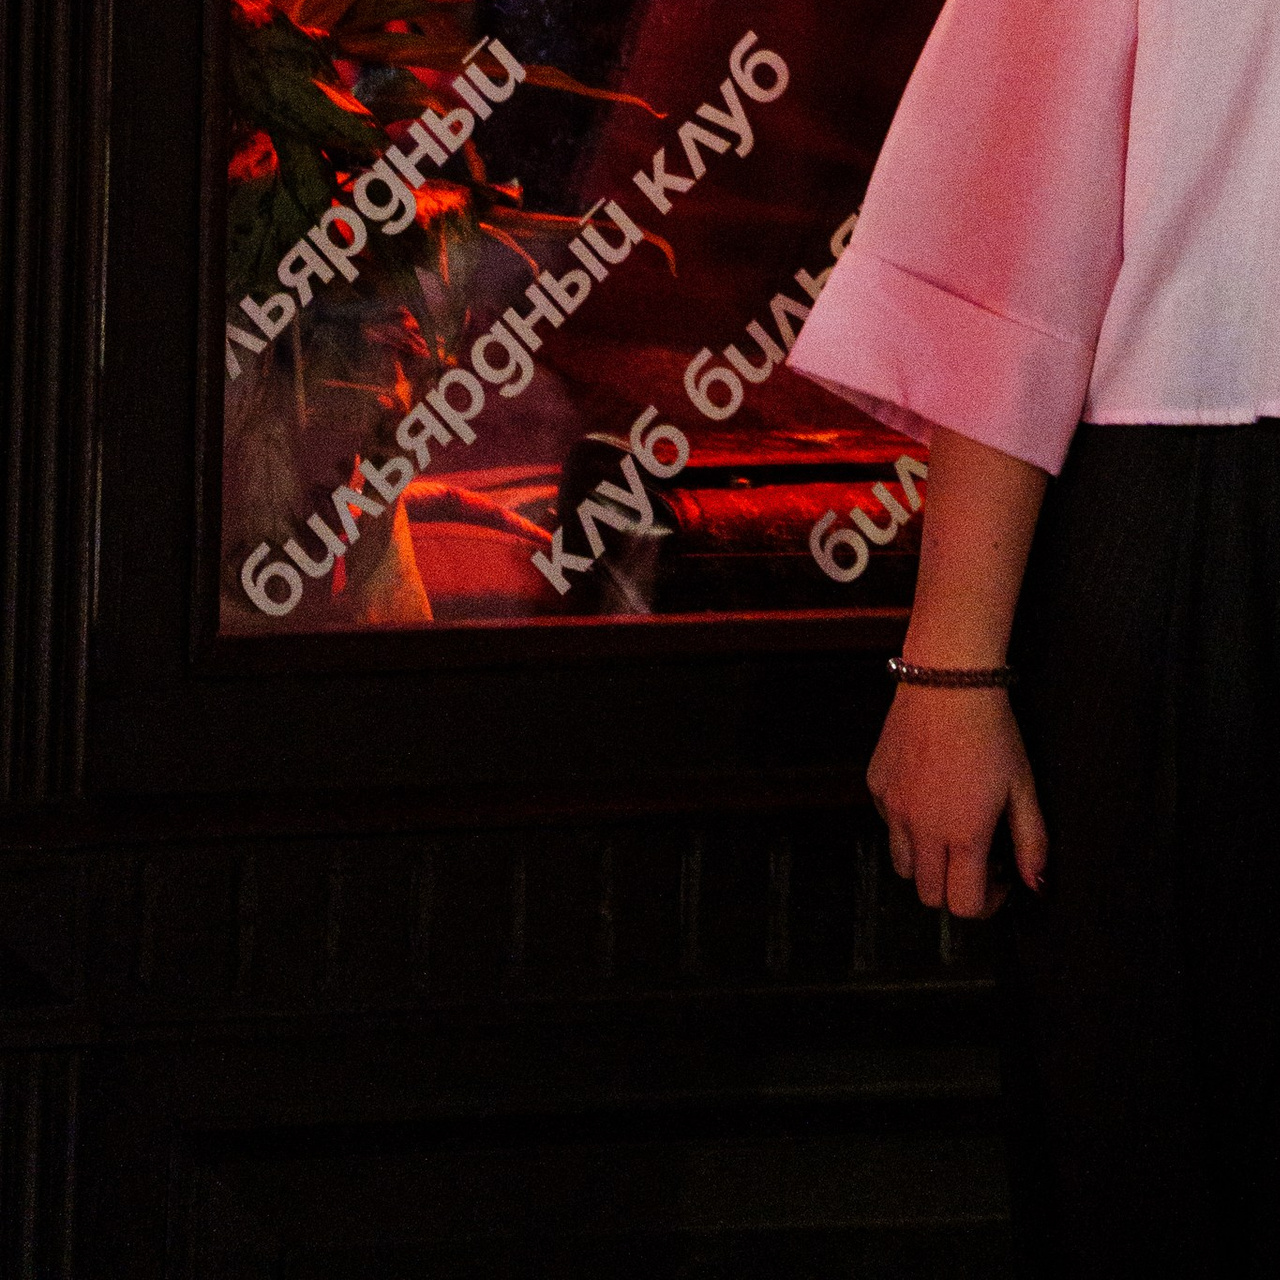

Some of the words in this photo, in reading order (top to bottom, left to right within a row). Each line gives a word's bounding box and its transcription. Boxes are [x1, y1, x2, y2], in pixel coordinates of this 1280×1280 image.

[240, 197, 646, 618] бильярдный
[632, 30, 791, 215] клуб
[530, 404, 690, 596] клуб
